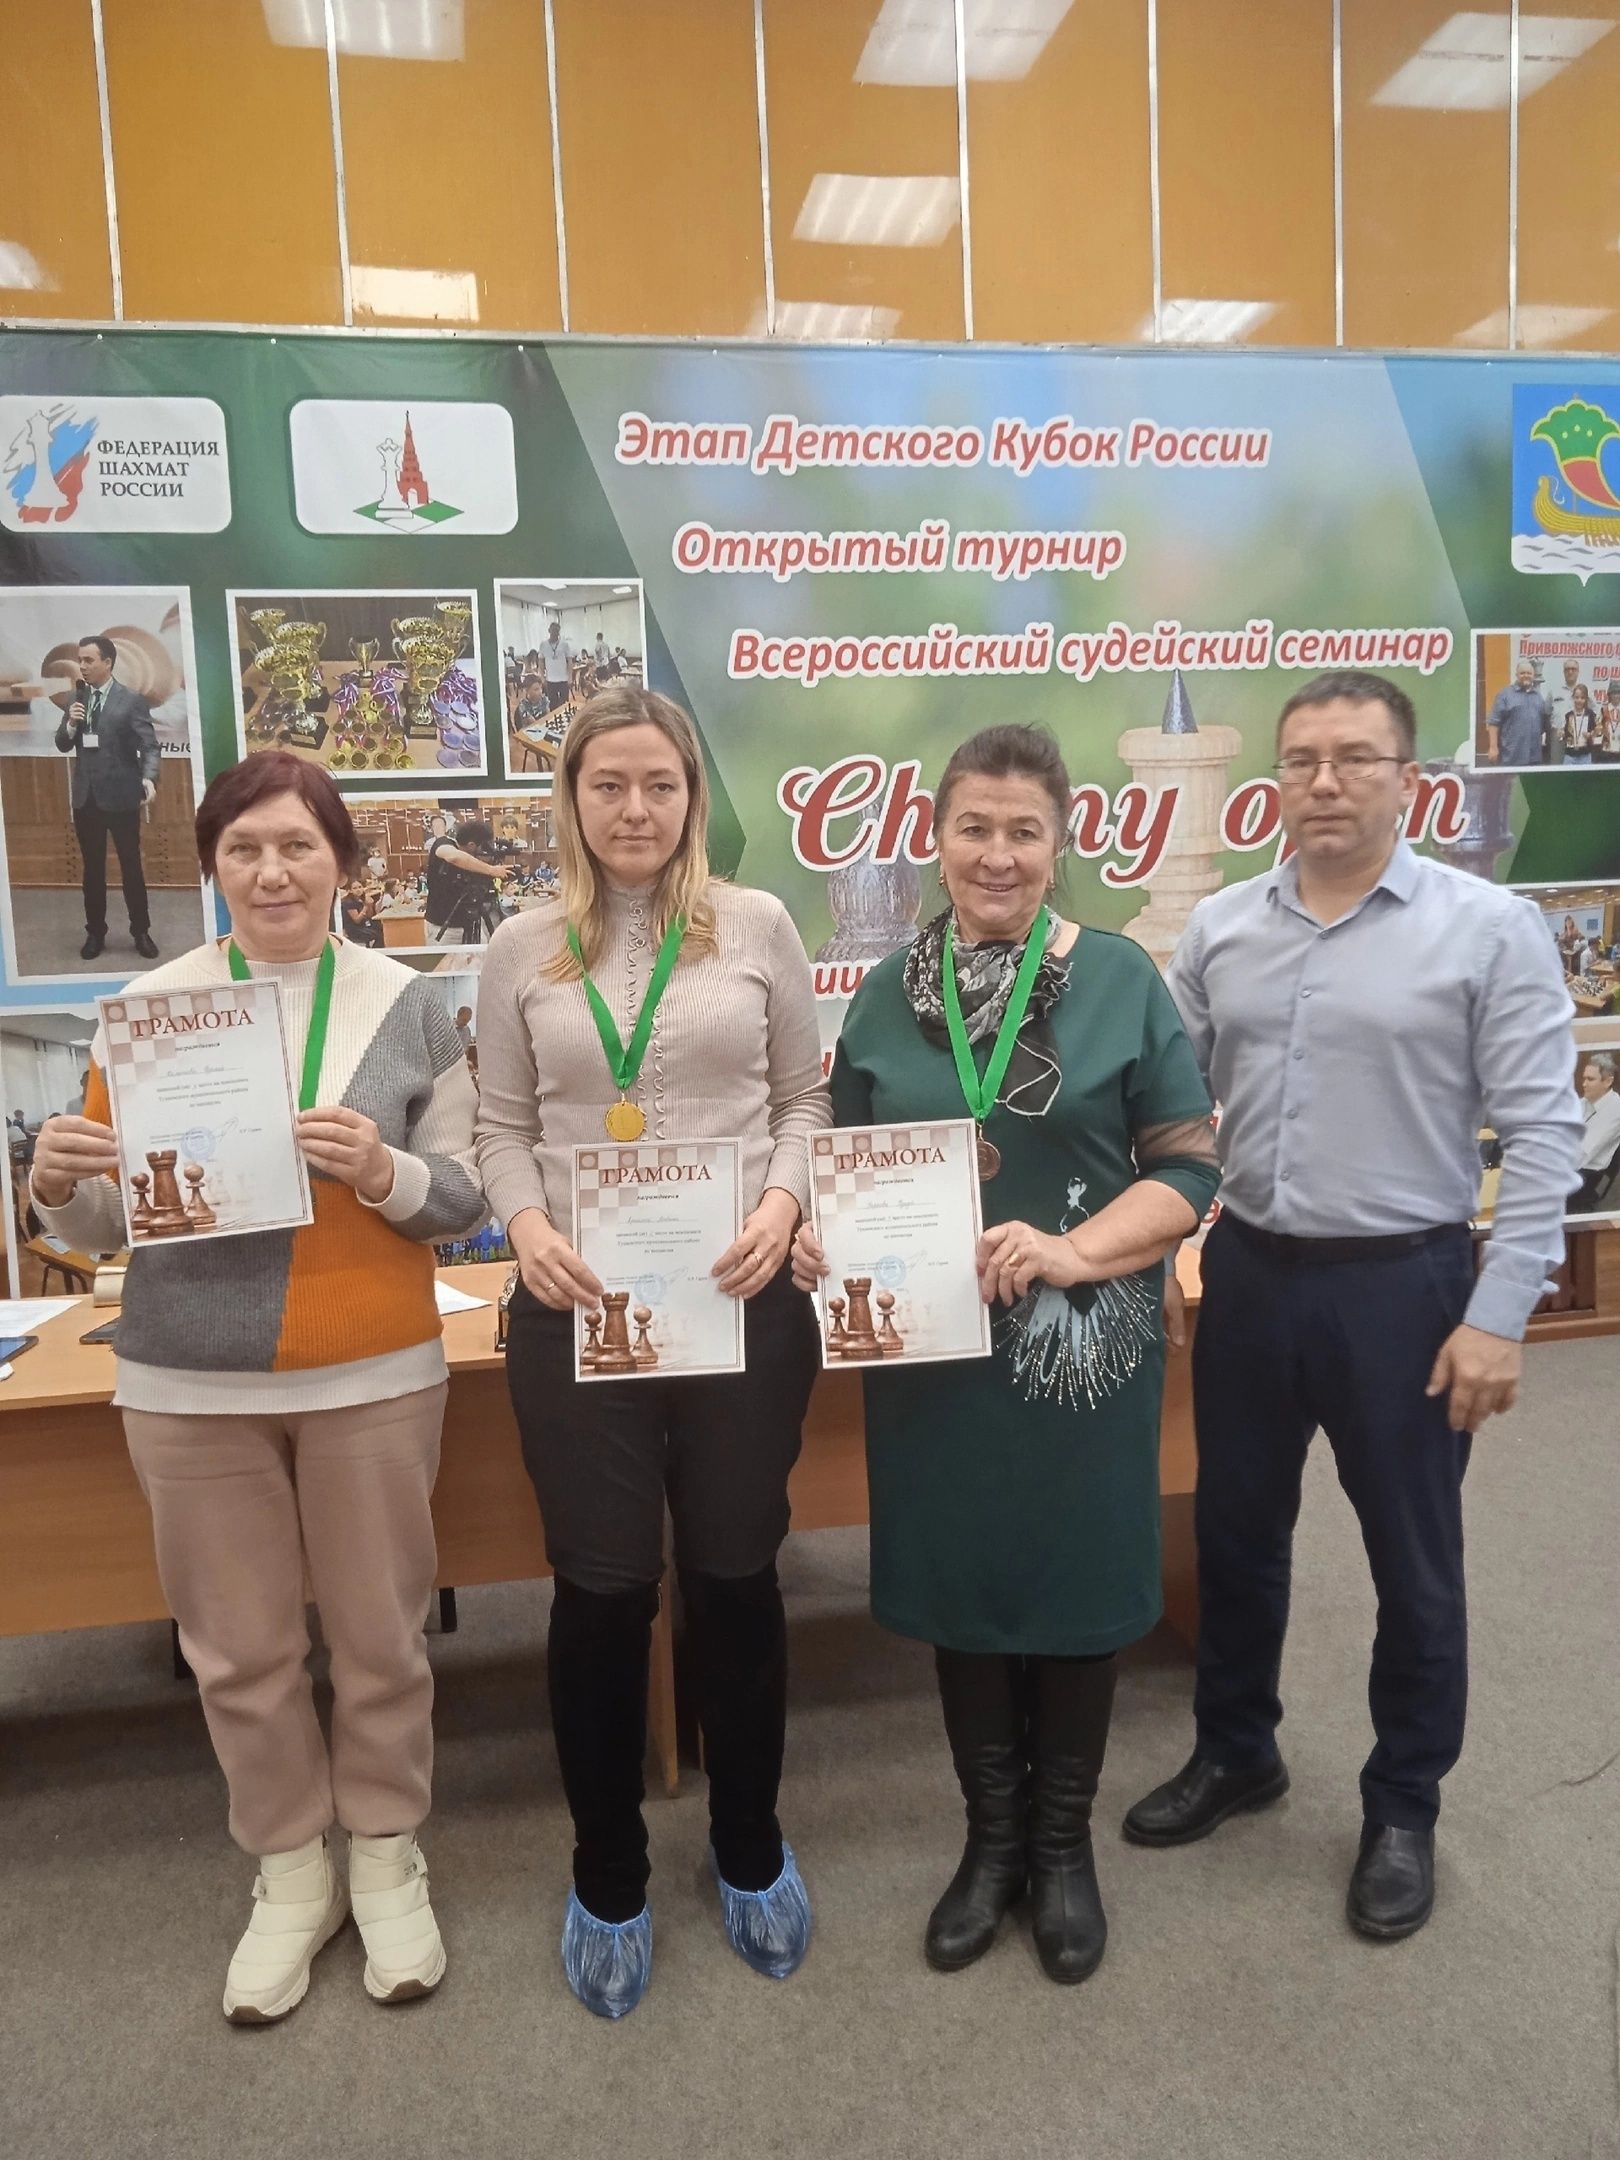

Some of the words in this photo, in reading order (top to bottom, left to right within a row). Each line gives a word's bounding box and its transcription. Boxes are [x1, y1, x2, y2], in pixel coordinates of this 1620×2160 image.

[97, 440, 219, 458] ФЕДЕРАЦИЯ
[621, 418, 747, 460] Этап
[757, 420, 981, 469] Детского
[994, 421, 1118, 470] Кубок
[1130, 424, 1268, 462] России
[99, 461, 189, 476] ШАХМАТ
[100, 482, 184, 497] РОССИИ
[677, 526, 946, 576] Открытый
[957, 535, 1122, 575] турнир
[733, 628, 1050, 682] Всероссийский
[1060, 625, 1270, 677] судейский
[1280, 633, 1449, 669] семинар
[1519, 640, 1613, 657] Приволжского
[782, 759, 1180, 884] Chny
[1224, 777, 1465, 866] on
[133, 1008, 255, 1037] ГРАМОТА
[836, 1147, 946, 1170] ГРАМОТА
[602, 1164, 713, 1184] ГРАМОТА
